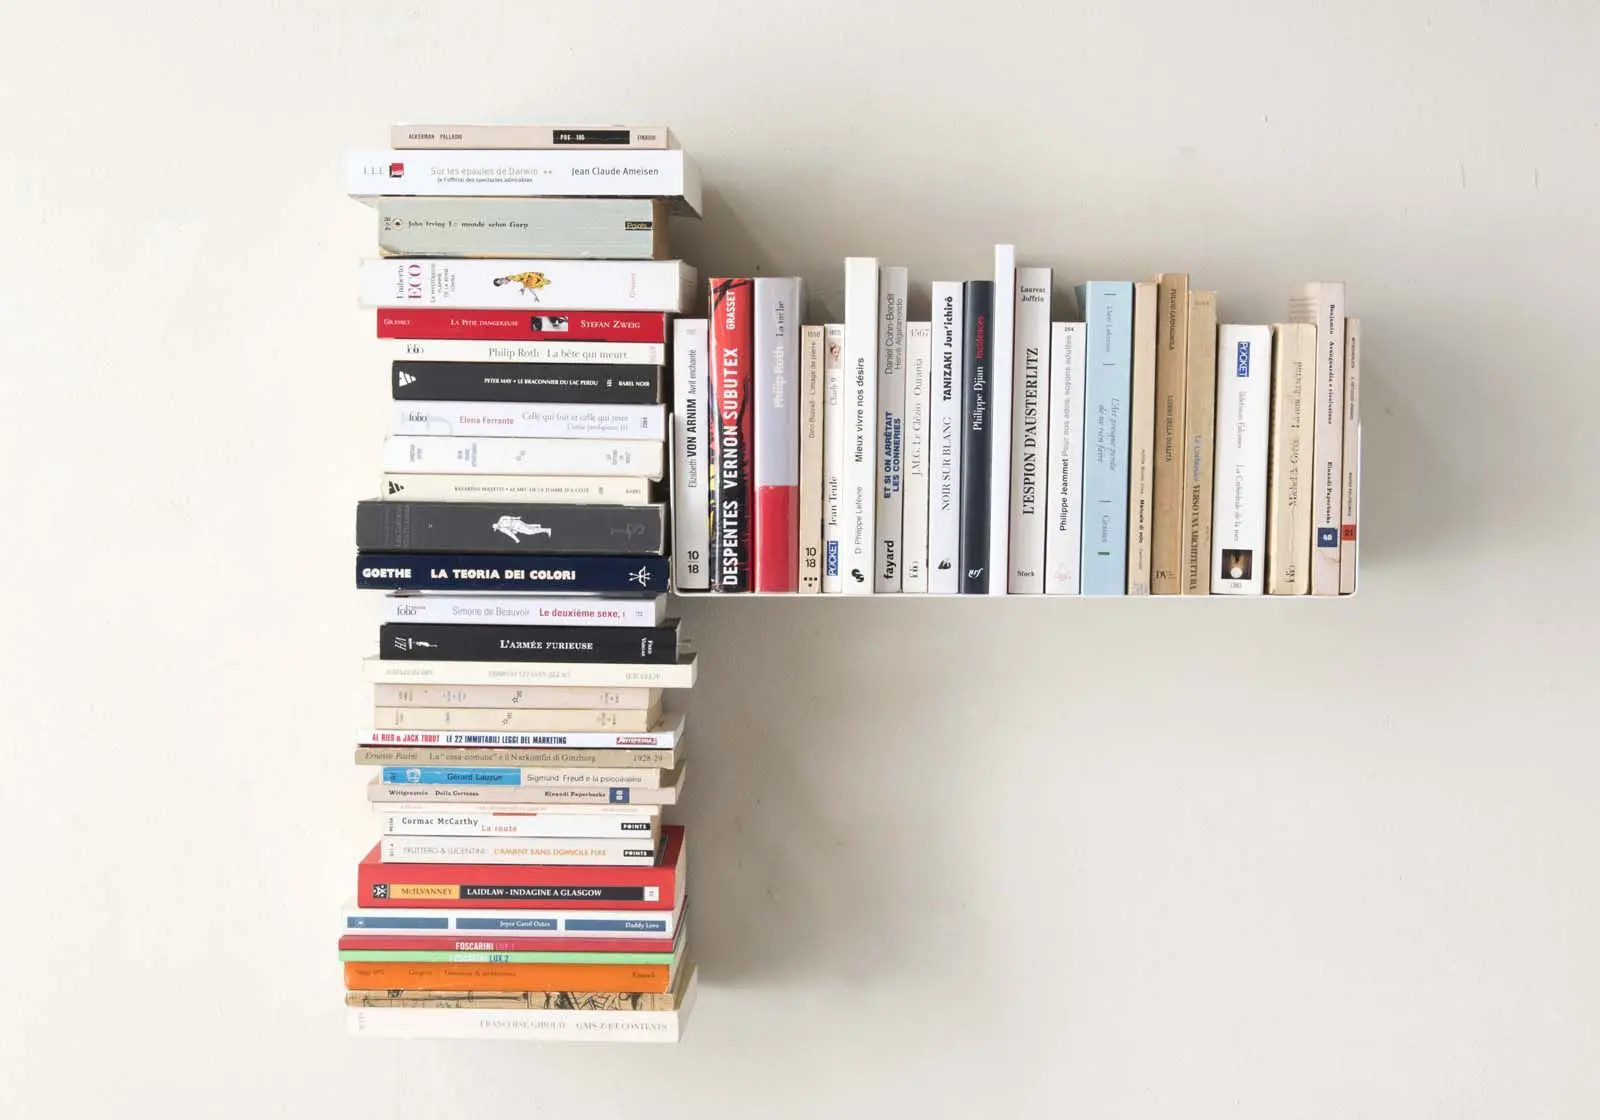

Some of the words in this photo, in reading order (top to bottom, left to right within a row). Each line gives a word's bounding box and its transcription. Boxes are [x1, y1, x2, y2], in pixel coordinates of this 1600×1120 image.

[497, 166, 508, 176] de
[509, 166, 538, 176] Darwin
[571, 167, 590, 177] Jean
[592, 167, 621, 177] Claude
[622, 167, 659, 177] Ameisen
[407, 264, 422, 300] ECO
[1020, 285, 1046, 294] Laurent
[725, 288, 737, 330] GRASSET
[884, 293, 896, 347] Cohn-Bendit
[580, 319, 610, 329] STEFAN
[612, 319, 641, 330] ZWEIG
[488, 347, 515, 360] Philip
[517, 348, 540, 358] Roth
[582, 349, 597, 362] qui
[772, 344, 785, 374] Roth
[884, 348, 894, 375] Daniel
[1237, 342, 1249, 377] POCKET
[483, 377, 500, 385] PETER
[722, 347, 739, 420] SUBUTEX
[855, 357, 865, 387] désirs
[943, 351, 953, 401] TANIZAKI
[973, 366, 987, 391] Djian
[687, 379, 697, 395] Avril
[772, 375, 787, 408] Philip
[856, 389, 865, 407] nos
[1024, 347, 1039, 448] D'AUSTERLITZ
[459, 416, 481, 425] Elena
[482, 416, 515, 426] Ferrante
[686, 398, 697, 433] ARNIM
[855, 409, 865, 433] vivre
[973, 393, 986, 431] Philippe
[882, 411, 893, 457] ARRÊTAIT
[892, 418, 902, 472] CONNERIES
[942, 417, 953, 457] BLANC
[686, 435, 697, 458] VON
[722, 424, 739, 489] VERNON
[854, 434, 865, 463] Mieux
[687, 458, 697, 488] Elizabeth
[884, 458, 893, 473] ON
[941, 457, 953, 482] SUR
[1060, 458, 1069, 496] Jeammet
[883, 475, 892, 484] SI
[892, 475, 901, 492] LES
[1022, 452, 1037, 515] L'ESPION
[883, 486, 892, 499] ET
[941, 483, 952, 511] NOIR
[828, 505, 839, 527] Jean
[1059, 498, 1069, 532] Philippe
[722, 500, 739, 586] DESPENTES
[805, 547, 817, 557] 10
[688, 550, 699, 560] 10
[806, 558, 817, 568] 18
[827, 541, 839, 576] POCKET
[883, 540, 897, 580] fayard
[361, 568, 412, 579] GOETHE
[430, 568, 449, 579] LA
[452, 568, 500, 580] TEORIA
[504, 569, 526, 580] DEI
[529, 569, 577, 581] COLORI
[688, 563, 699, 574] 18
[1017, 569, 1035, 578] Stock
[451, 606, 482, 617] Simone
[539, 607, 550, 617] Le
[551, 607, 595, 618] deuxième
[402, 733, 420, 744] JACK
[446, 734, 453, 744] LE
[454, 734, 463, 744] 22
[520, 735, 531, 746] DEL
[532, 736, 567, 747] MARKETING
[526, 774, 560, 786] Sigmund
[562, 774, 584, 784] Freud
[402, 817, 434, 827] Cormac
[437, 817, 479, 829] McCarthy
[481, 824, 490, 833] La
[622, 822, 647, 831] POINTS
[466, 888, 505, 898] LAIDLAW
[510, 888, 552, 898] INDAGINE
[552, 888, 560, 898] A
[560, 888, 603, 899] GLASGOW
[455, 942, 494, 951] FOSCARINI
